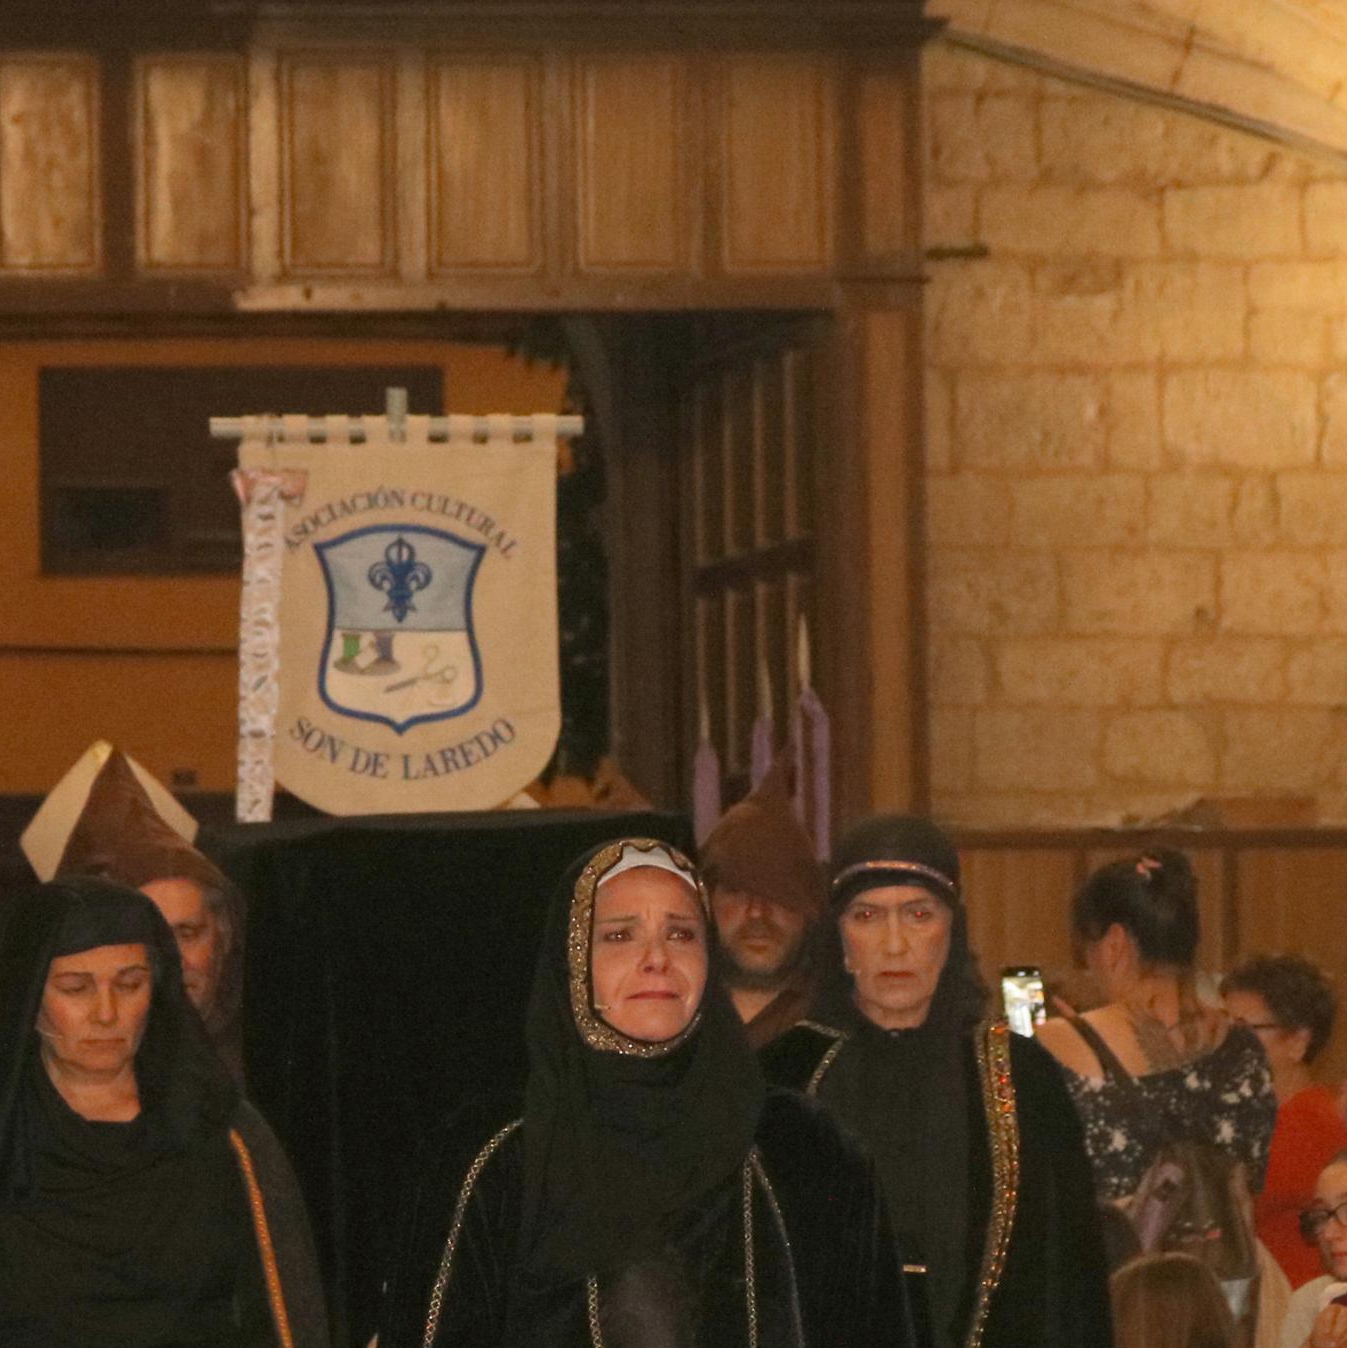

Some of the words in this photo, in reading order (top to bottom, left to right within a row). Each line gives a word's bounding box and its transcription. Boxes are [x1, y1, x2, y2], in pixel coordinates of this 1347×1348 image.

[285, 485, 405, 552] ASOCIACIÓN
[410, 491, 517, 558] CULTURAL
[289, 716, 345, 765] SON
[349, 746, 390, 779] DE
[401, 718, 516, 780] LAREDO
